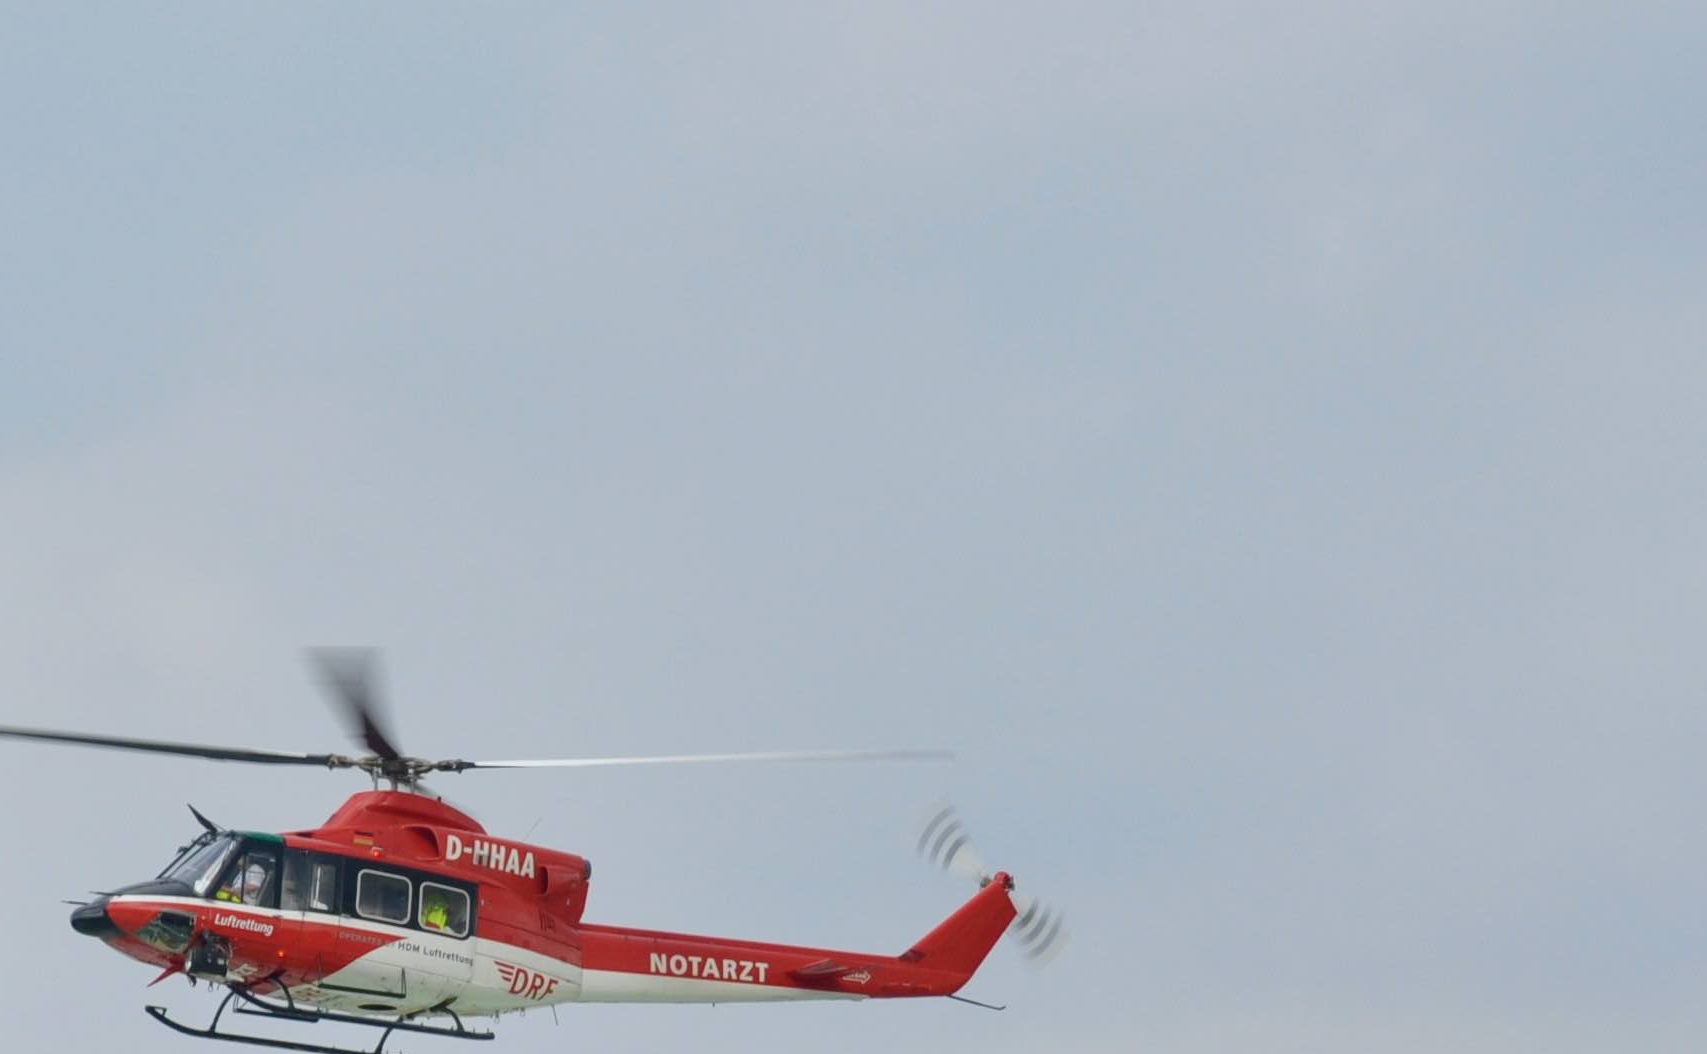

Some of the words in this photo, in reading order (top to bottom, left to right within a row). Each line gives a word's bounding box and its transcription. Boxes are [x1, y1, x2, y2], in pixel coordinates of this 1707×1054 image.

[445, 834, 535, 879] D-HHAA
[214, 913, 273, 936] Luftrettung
[398, 941, 420, 952] HDM
[423, 947, 474, 967] Luftrettung
[649, 953, 769, 983] NOTARZT
[508, 967, 559, 1001] DRF
